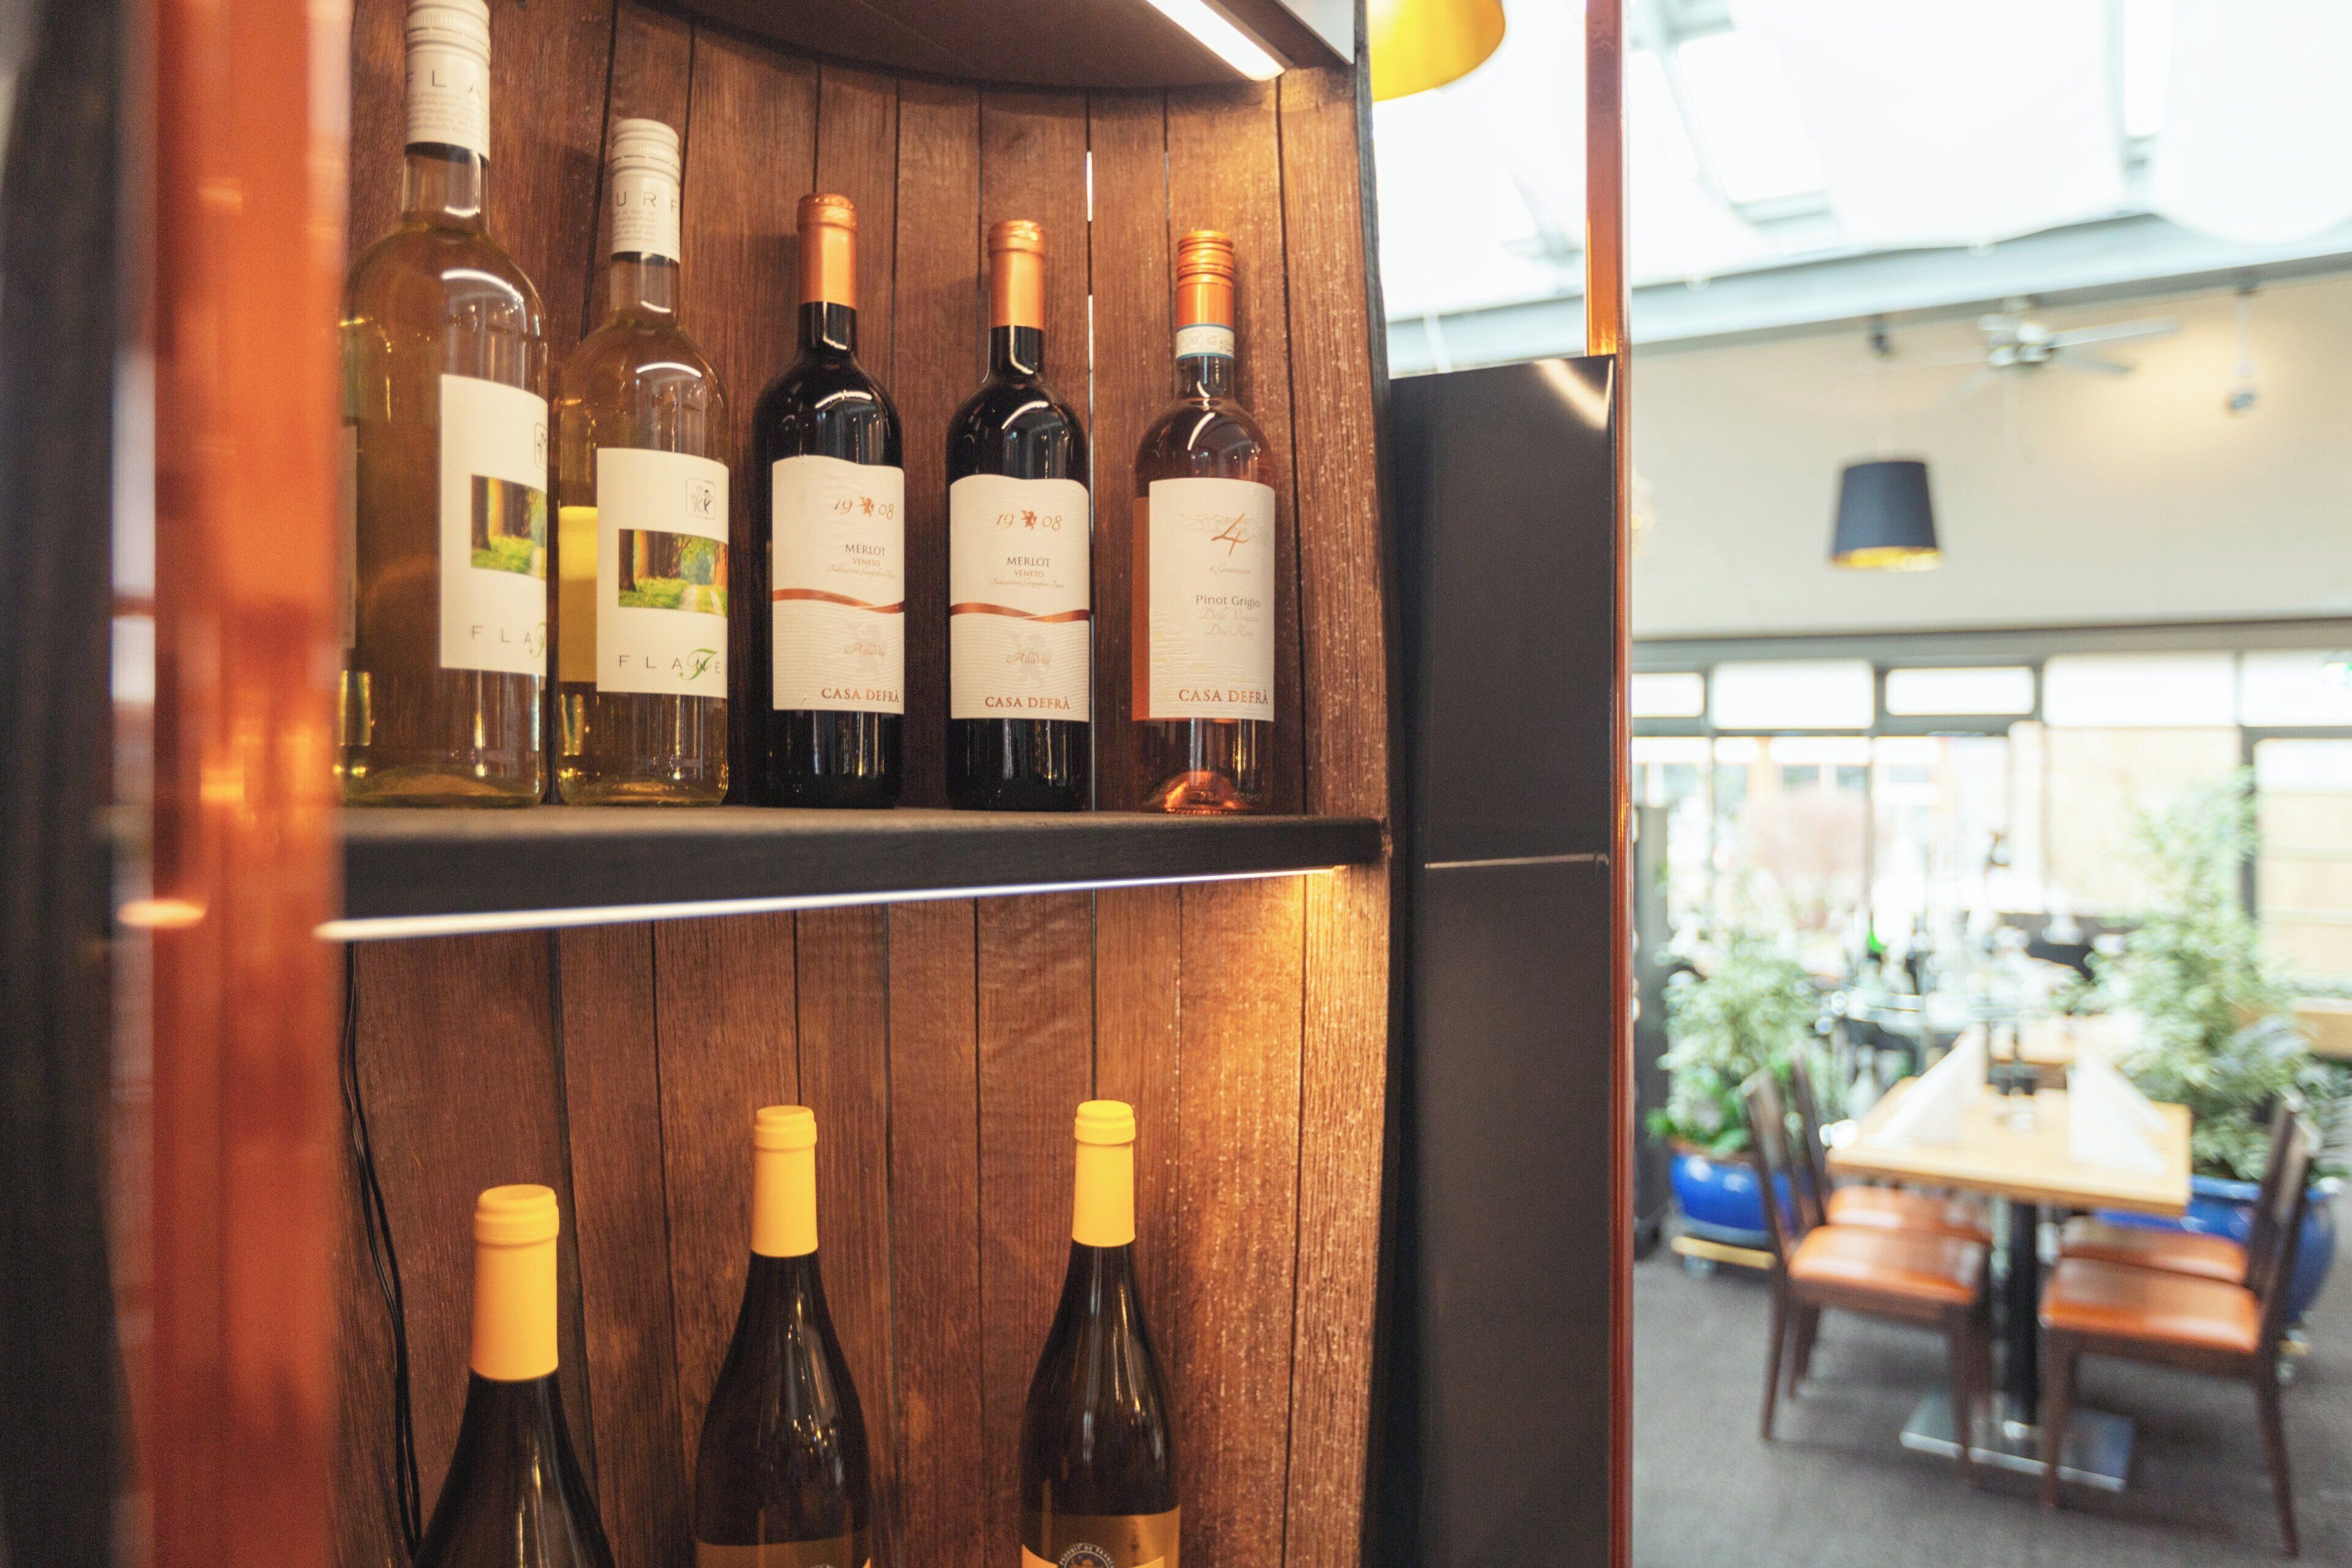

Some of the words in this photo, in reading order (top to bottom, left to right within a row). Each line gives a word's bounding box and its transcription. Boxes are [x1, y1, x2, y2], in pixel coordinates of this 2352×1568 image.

[834, 498, 853, 515] 19
[879, 503, 894, 520] 08
[996, 513, 1015, 530] 19
[1042, 514, 1062, 532] 08
[1211, 512, 1250, 557] 4
[845, 543, 886, 557] MERLOT
[852, 557, 881, 567] VENETO
[1006, 556, 1051, 568] MERLOT
[1014, 569, 1044, 578] VENETO
[1196, 594, 1228, 605] Pinot
[1231, 595, 1261, 609] Grigio
[619, 654, 727, 676] FLANE
[821, 687, 861, 700] CASA
[866, 689, 899, 703] DEFRÀ
[1178, 689, 1223, 703] CASA
[1228, 689, 1269, 704] DEFRÀ
[984, 696, 1023, 708] CASA
[1027, 696, 1071, 710] DEFRÀ
